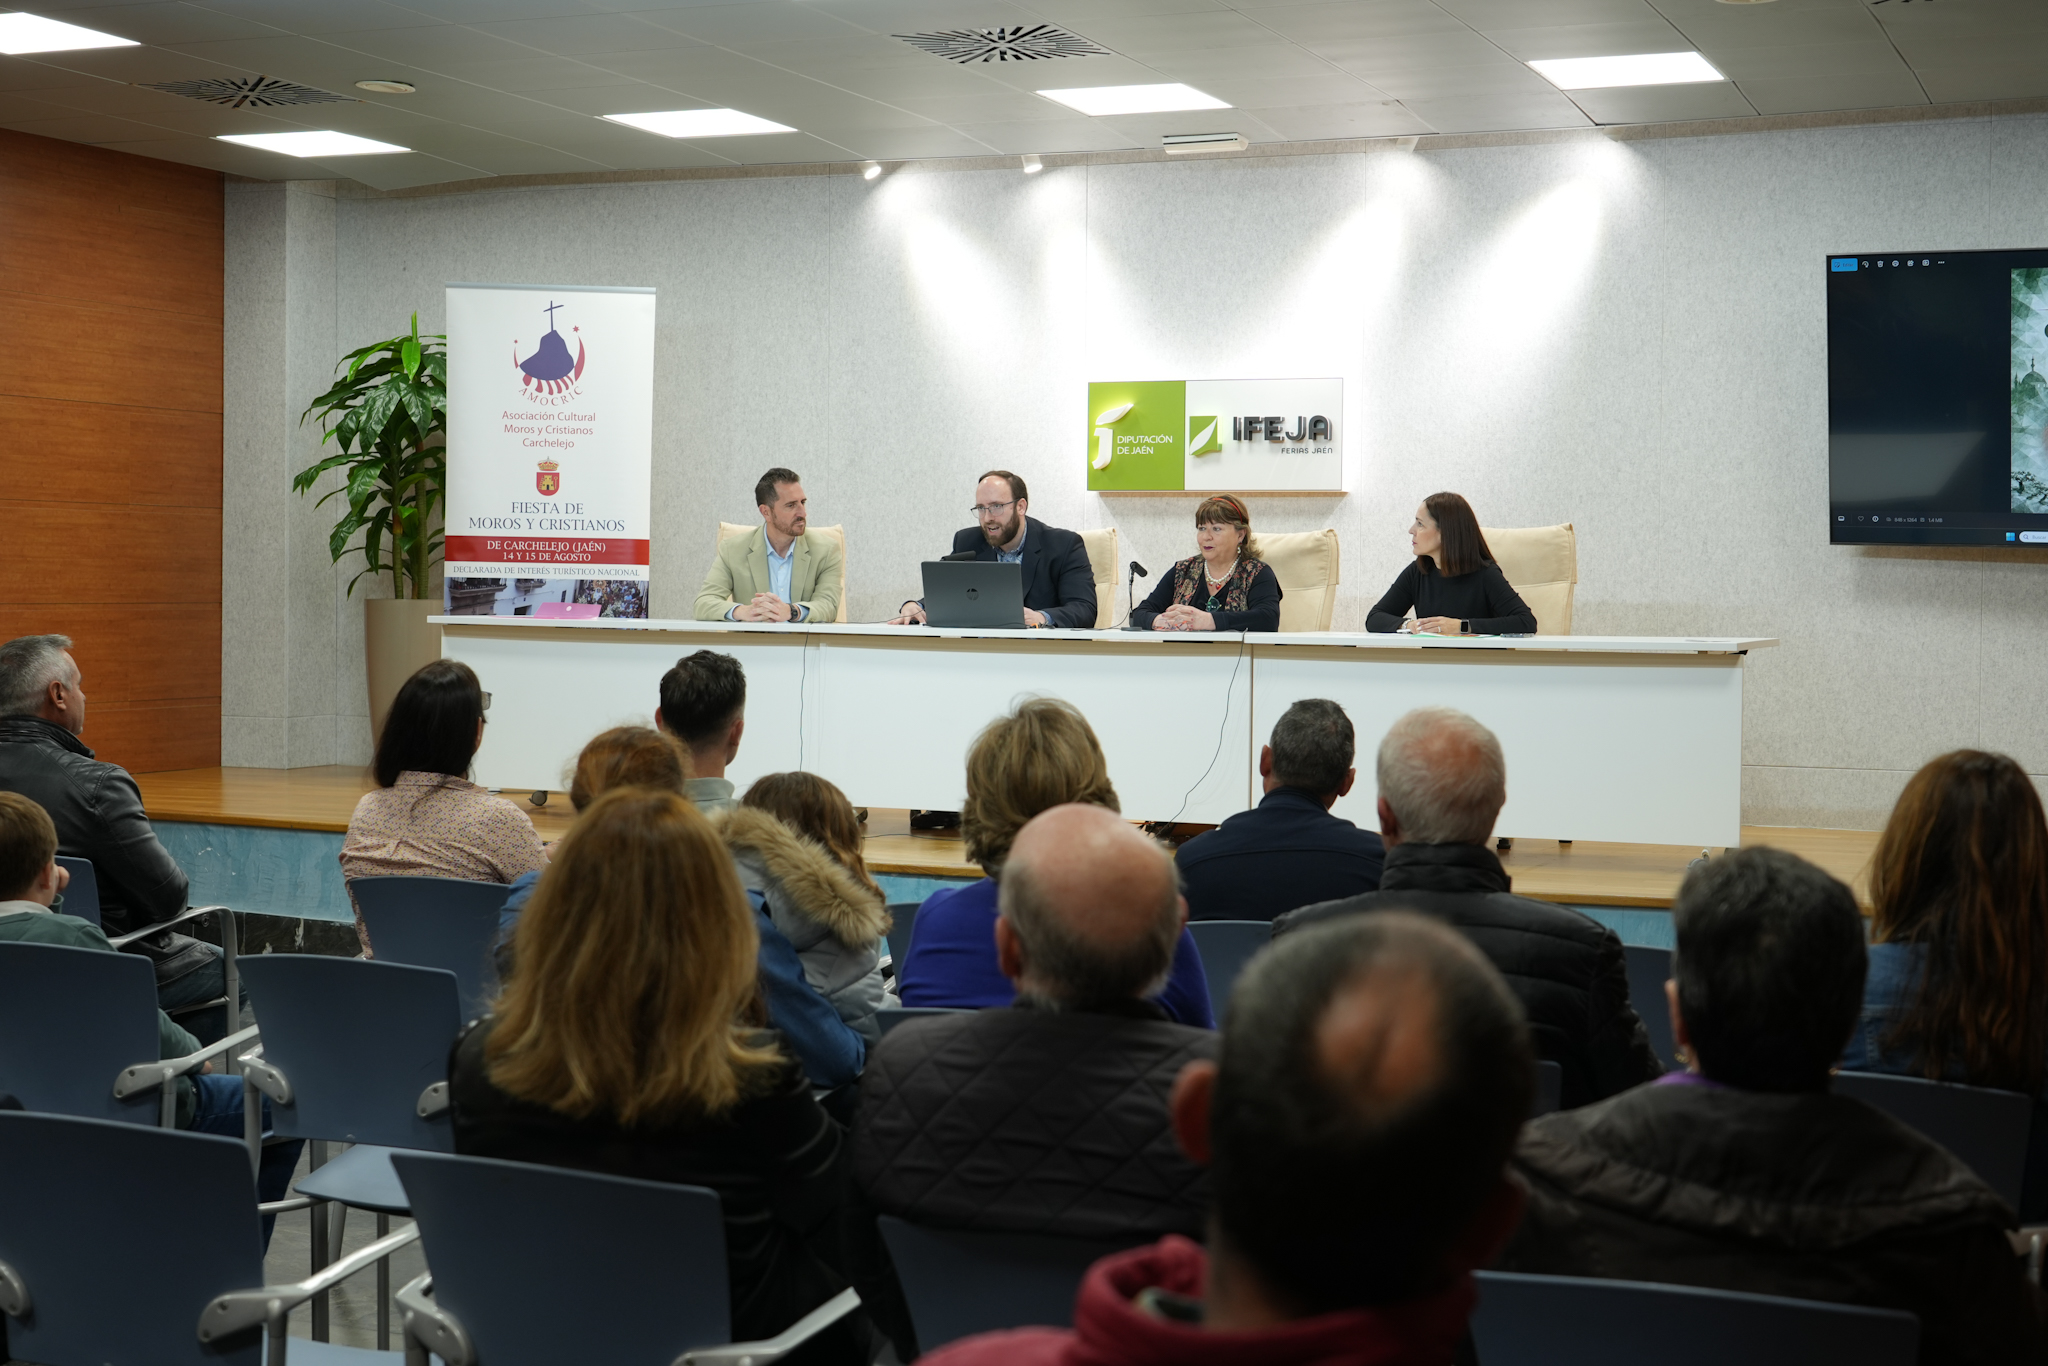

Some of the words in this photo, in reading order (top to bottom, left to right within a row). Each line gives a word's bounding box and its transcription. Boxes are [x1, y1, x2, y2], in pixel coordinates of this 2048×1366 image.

[518, 385, 584, 407] AMOCRIC
[502, 410, 555, 421] Asociación
[557, 411, 596, 422] Cultural
[504, 424, 535, 434] Moros
[537, 426, 543, 436] y
[545, 425, 594, 435] Cristianos
[1232, 414, 1333, 442] IFEJA
[522, 438, 575, 450] Carchelejo
[1117, 434, 1173, 444] DIPUTACIÓN
[1117, 446, 1130, 455] DE
[1130, 445, 1154, 455] JAÉN
[511, 502, 560, 514] FIESTA
[565, 503, 584, 515] DE
[469, 517, 521, 530] MOROS
[526, 518, 535, 530] Y
[539, 518, 625, 532] CRISTIANOS
[487, 540, 501, 550] DE
[503, 540, 570, 551] CARCHELEJO
[572, 540, 606, 553] (JAÉN)
[502, 552, 514, 560] 14
[516, 552, 523, 560] Y
[525, 552, 536, 560] 15
[538, 552, 551, 561] DE
[553, 552, 591, 561] AGOSTO
[453, 566, 503, 574] DECLARADA
[504, 566, 516, 574] DE
[517, 566, 551, 575] INTERÉS
[552, 566, 596, 576] TURÍSTICO
[597, 568, 640, 577] NACIONAL
